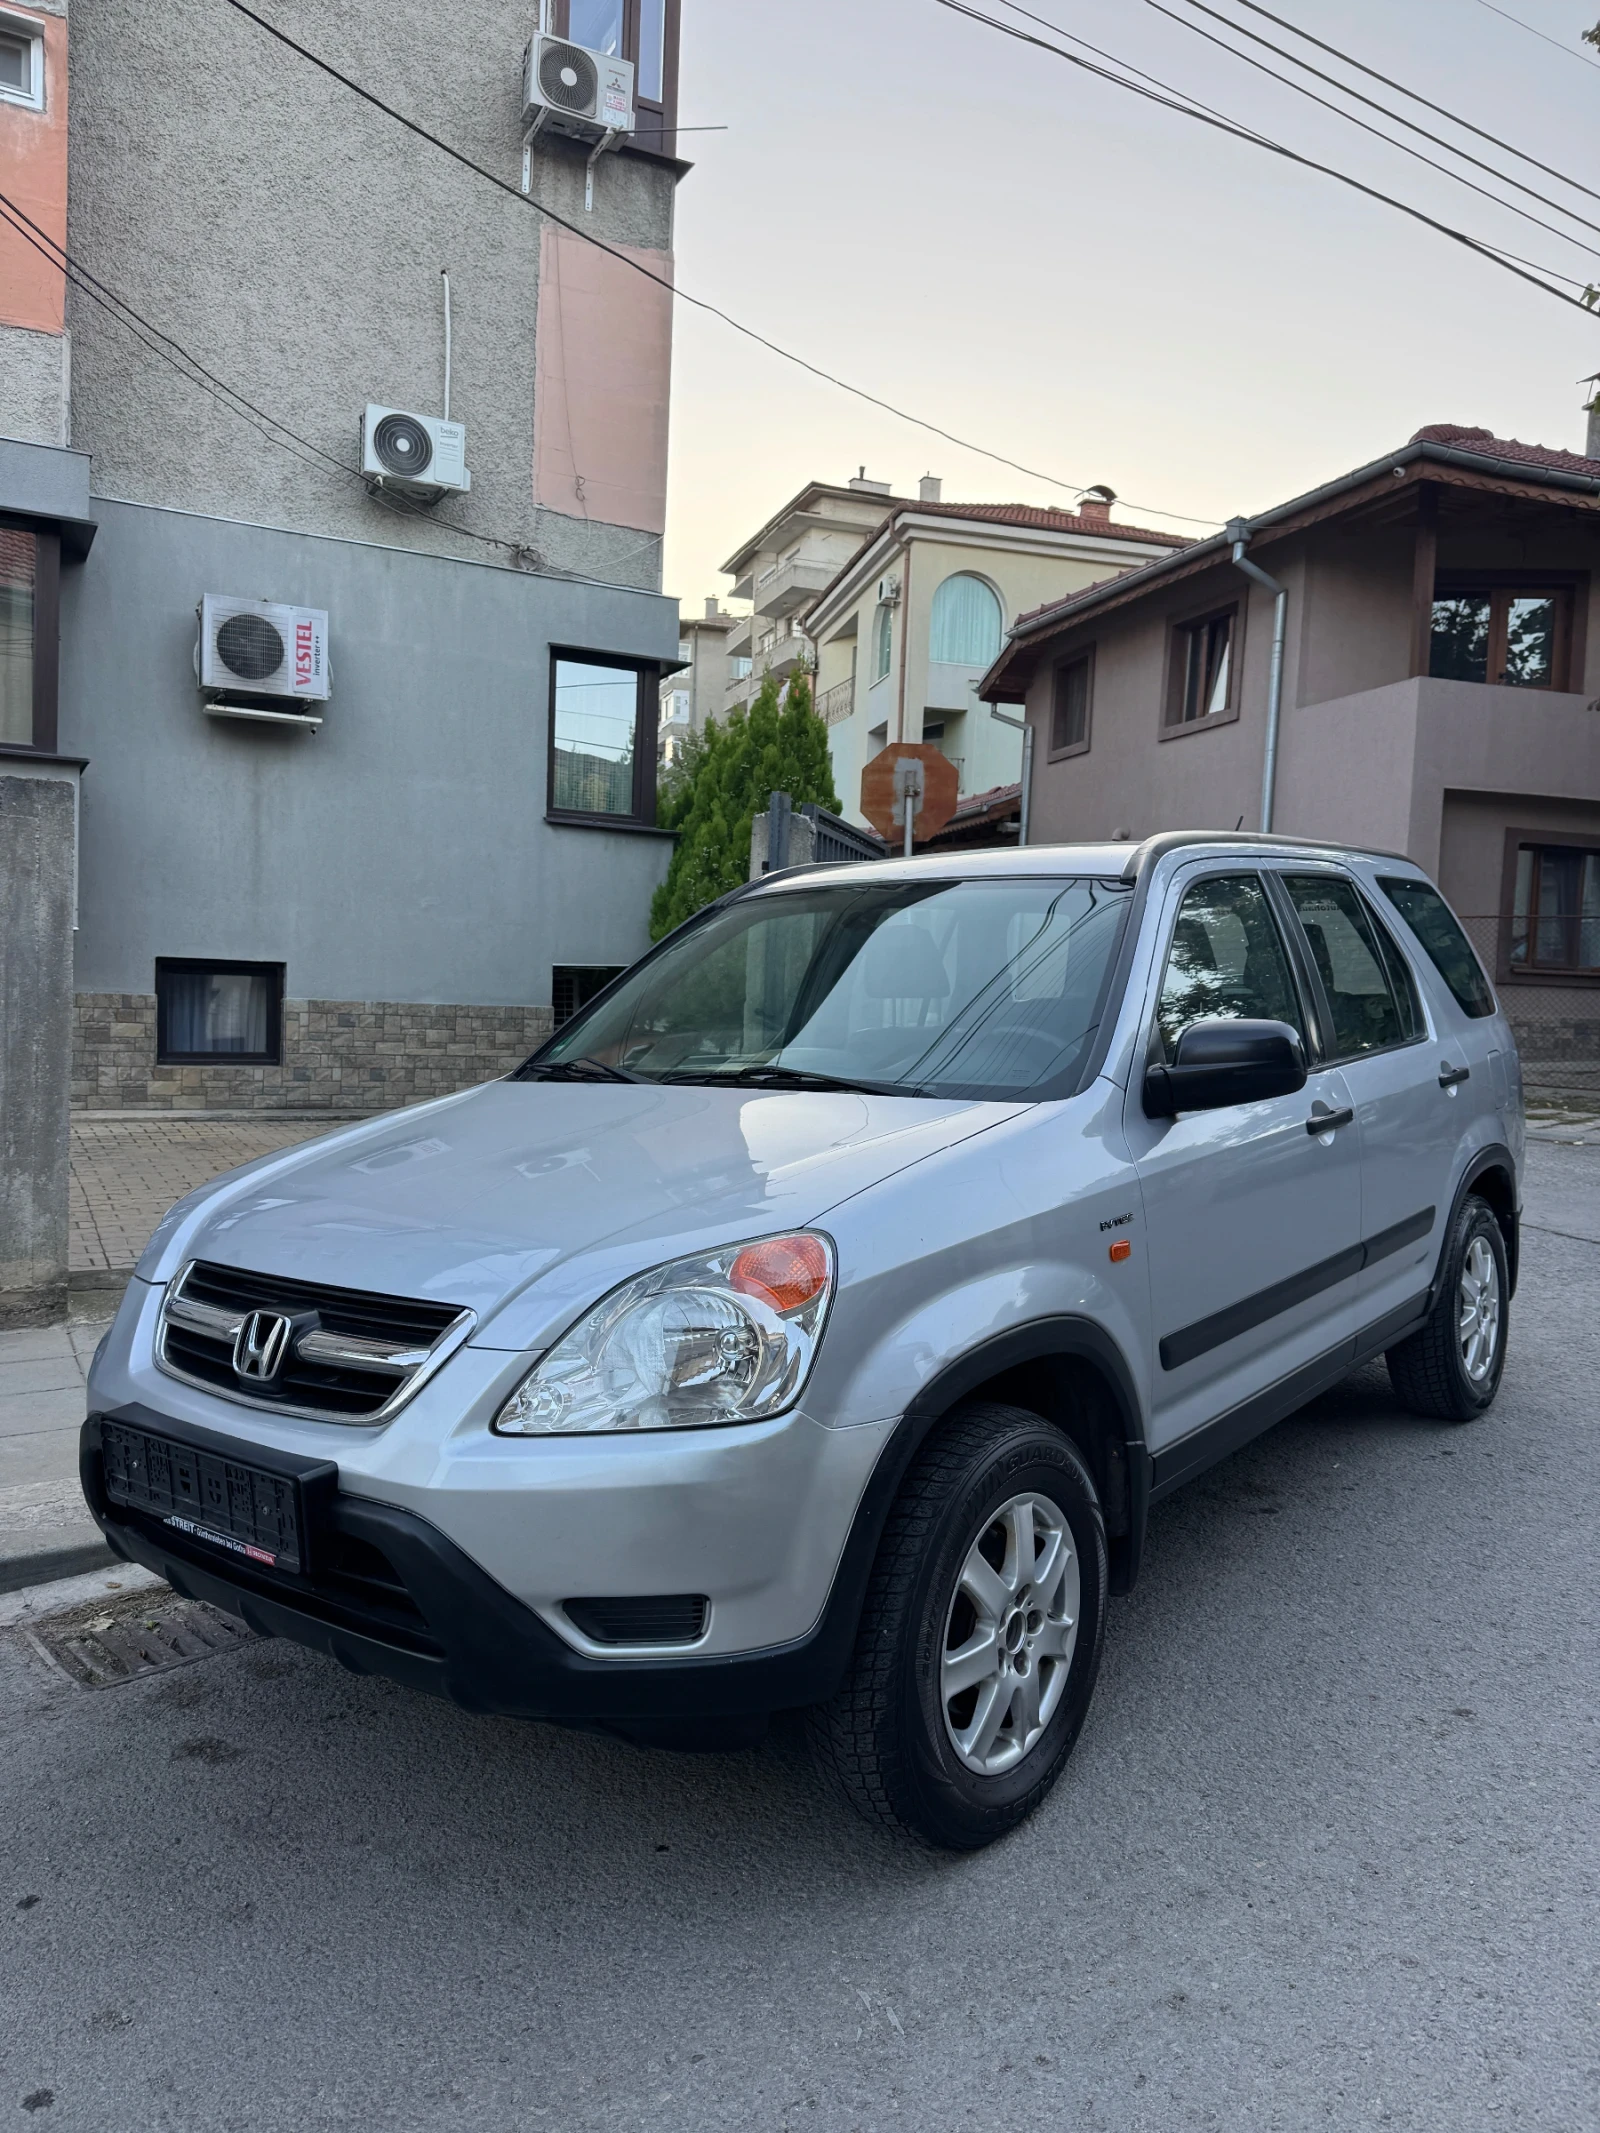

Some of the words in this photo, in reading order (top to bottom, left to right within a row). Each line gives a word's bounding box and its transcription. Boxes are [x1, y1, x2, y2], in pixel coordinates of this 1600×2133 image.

[440, 427, 459, 436] beko
[296, 621, 312, 686] VESTEL
[171, 1516, 194, 1533] STREIT
